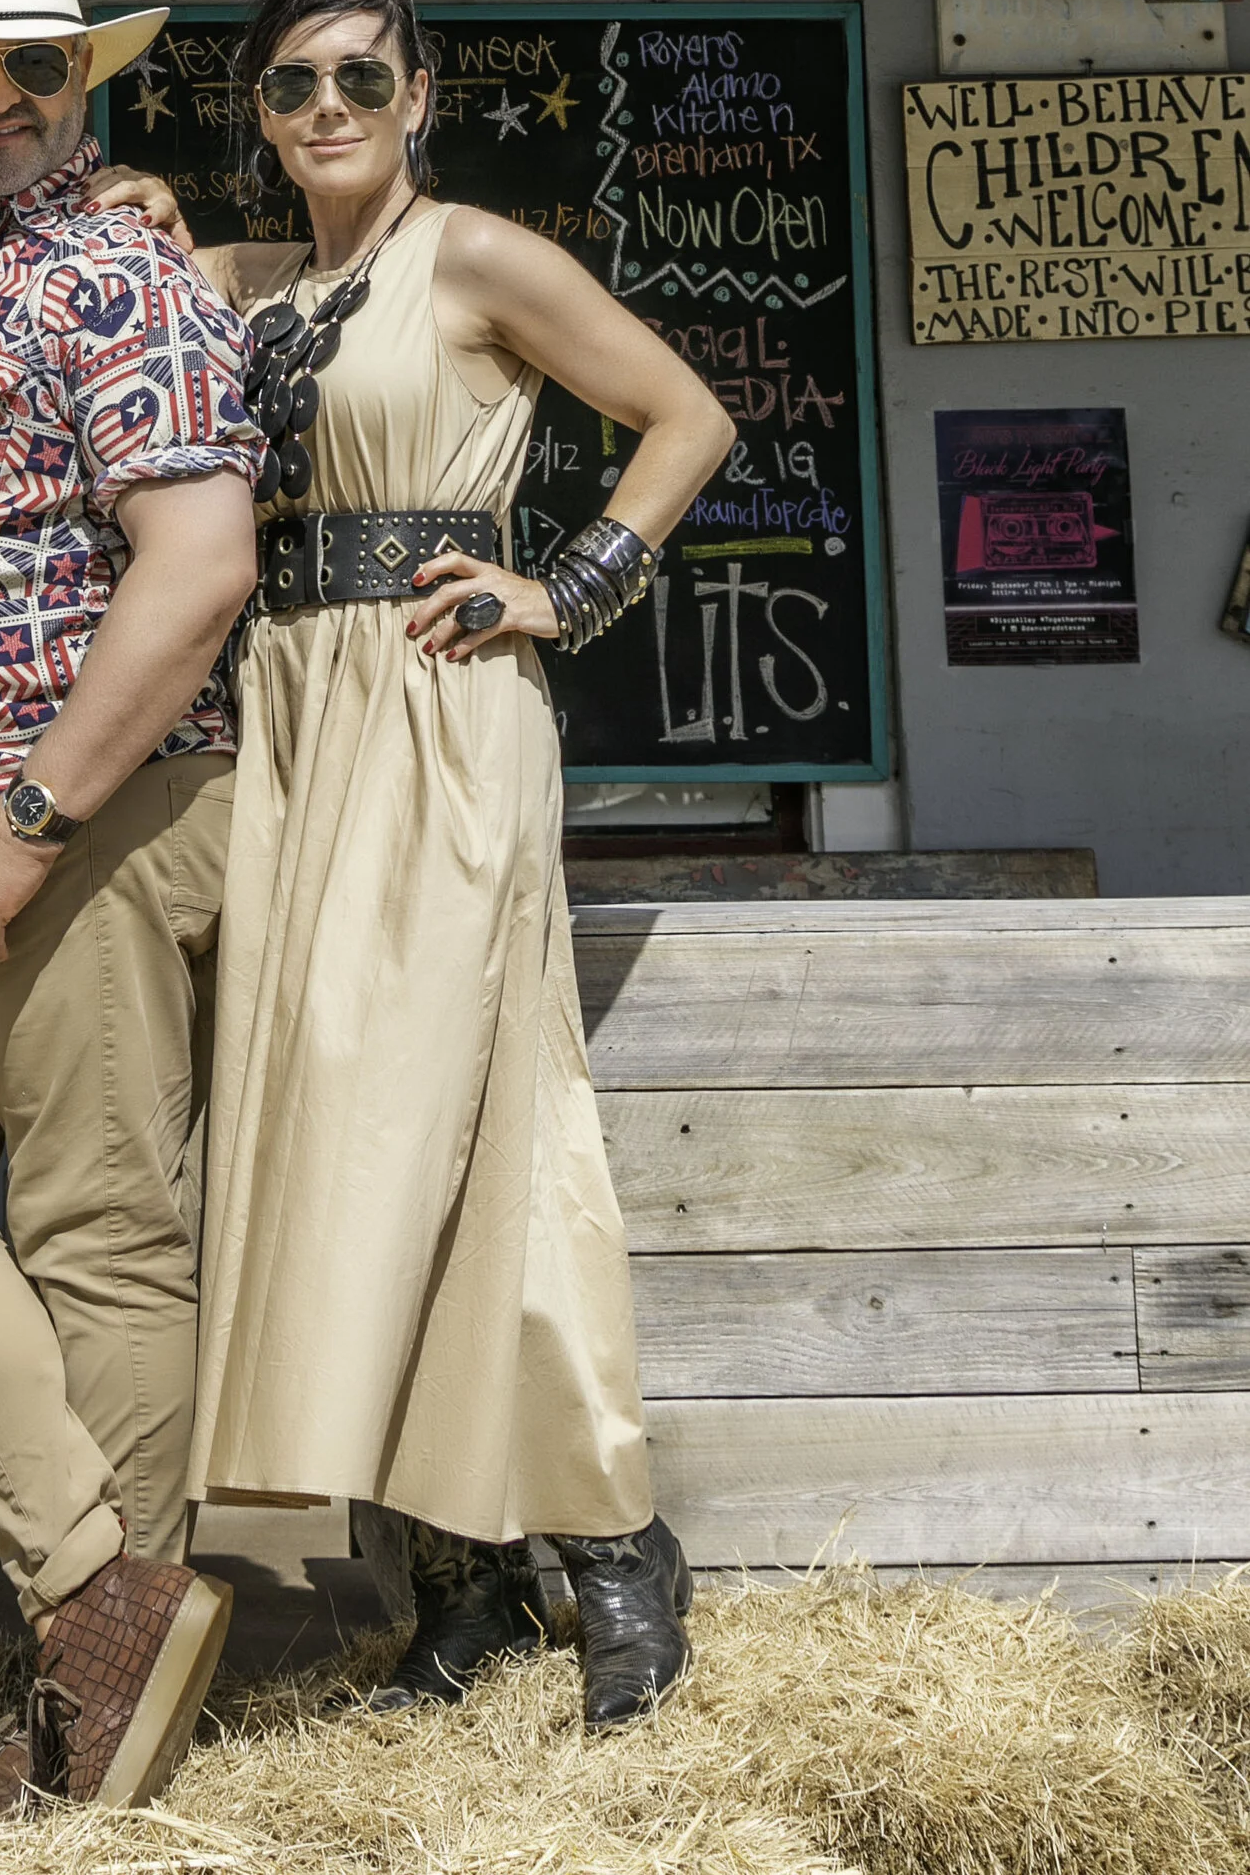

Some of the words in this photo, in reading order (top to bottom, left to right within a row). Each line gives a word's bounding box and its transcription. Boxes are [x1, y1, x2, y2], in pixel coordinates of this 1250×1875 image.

[458, 33, 562, 77] week
[638, 30, 744, 74] Royers
[680, 72, 781, 103] Alamo
[907, 82, 1034, 132] WELL
[653, 100, 794, 137] Kitchen
[632, 135, 773, 179] Brenham,
[780, 133, 821, 171] TX
[989, 181, 1206, 249] WELCOME
[925, 263, 1006, 303] THE
[1020, 257, 1111, 299] REST
[1118, 253, 1225, 297] WILL
[925, 305, 1031, 341] MADE
[1059, 299, 1139, 337] INTO
[1165, 299, 1250, 334] PIE
[708, 373, 844, 429] EDIA
[954, 448, 1008, 479] Black
[1010, 444, 1061, 487] Light
[1059, 446, 1110, 486] Party
